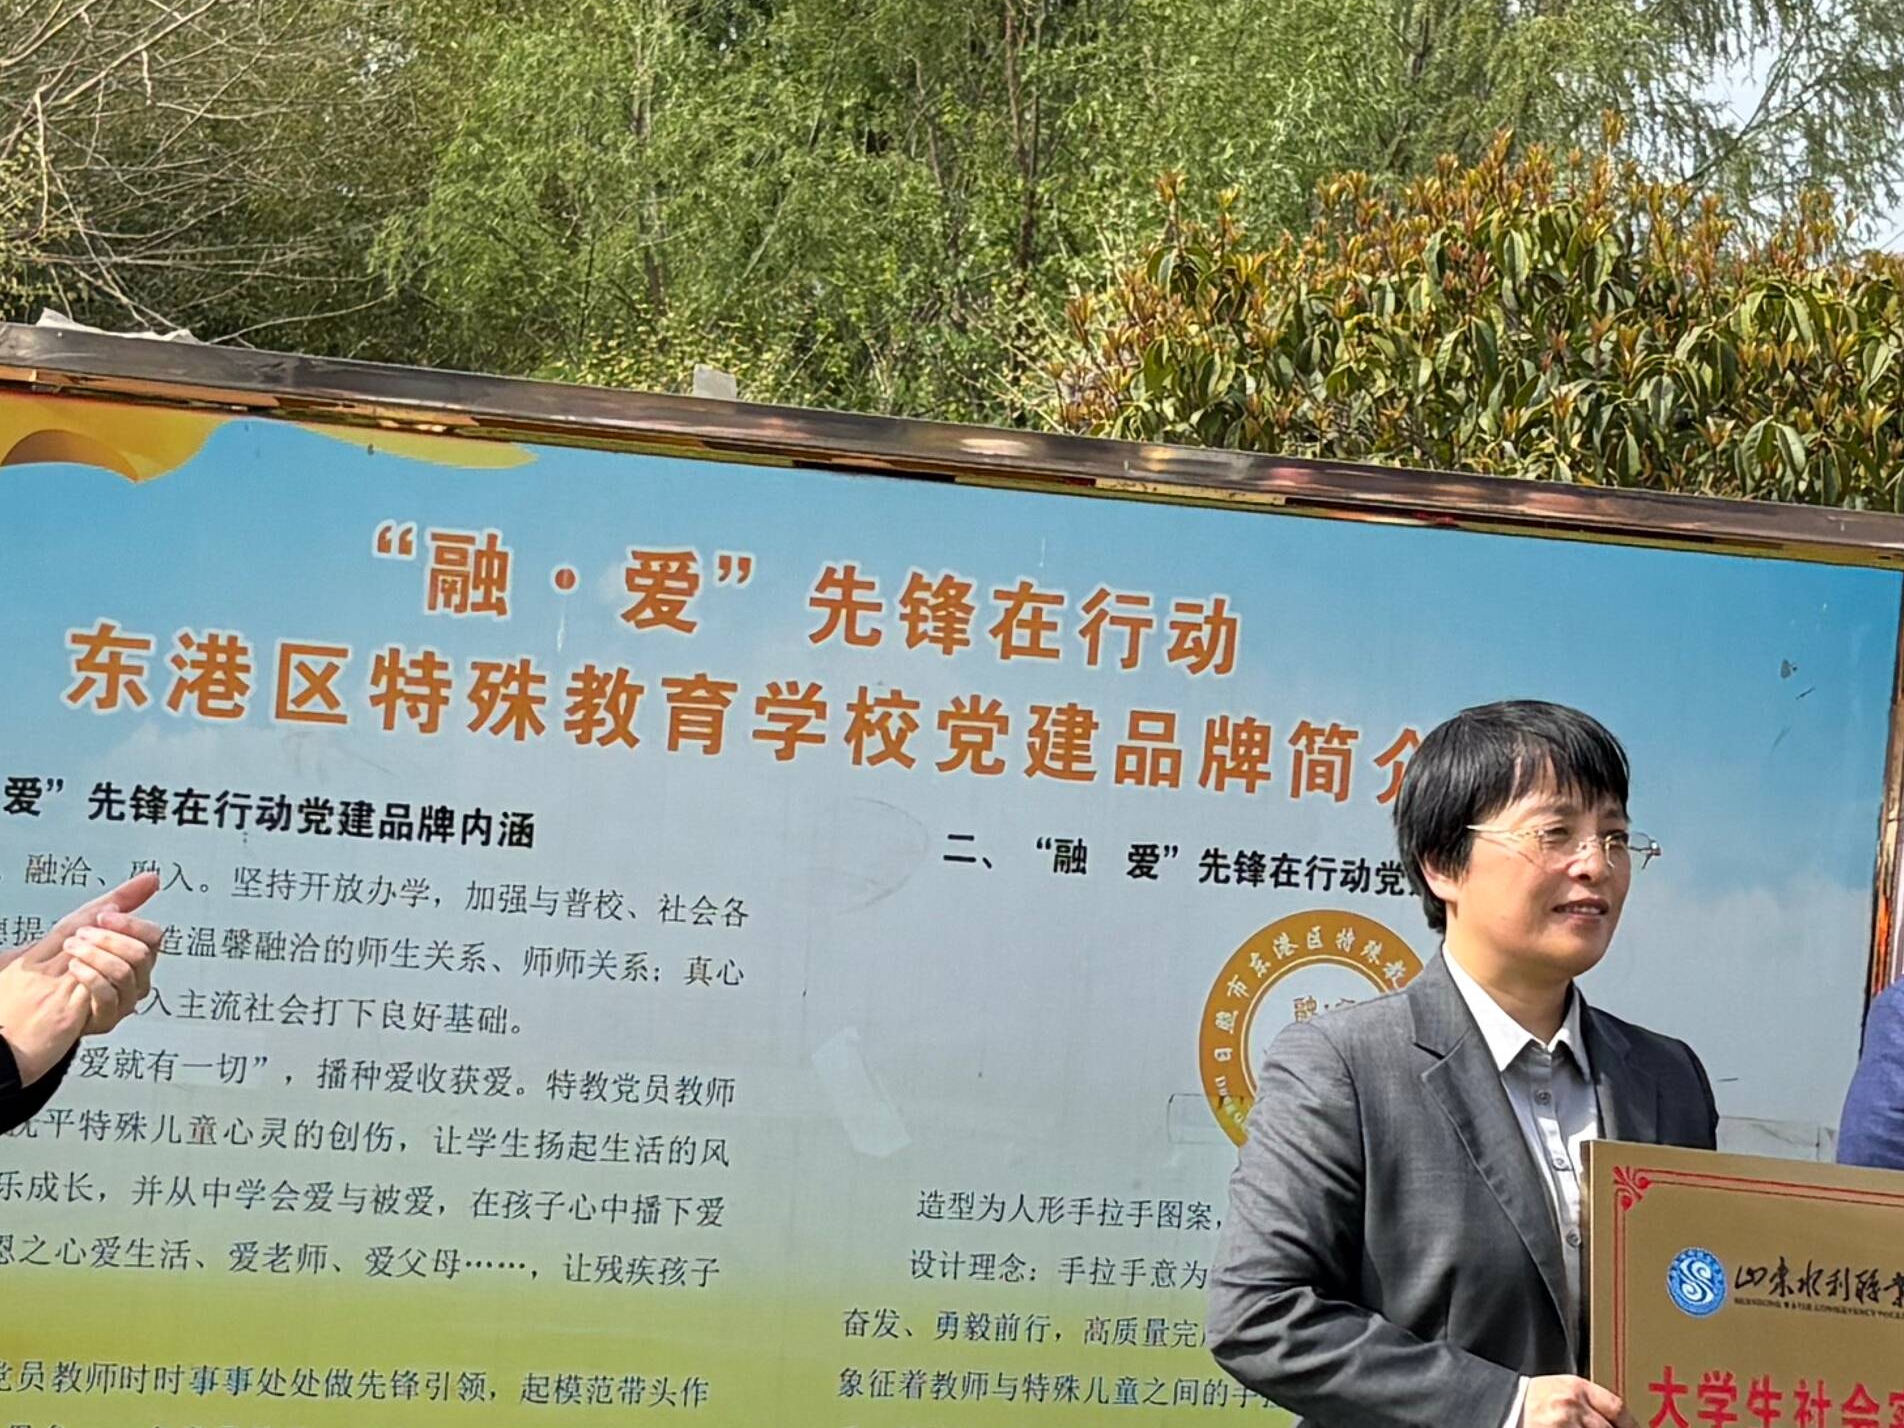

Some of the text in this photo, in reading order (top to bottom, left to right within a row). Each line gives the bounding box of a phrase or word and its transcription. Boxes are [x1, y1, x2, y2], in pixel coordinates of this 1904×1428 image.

[66, 621, 1419, 804] 东港区特殊教育学校党建品牌简介
[842, 1306, 1207, 1349] 奋发、勇毅前行，高质量完
